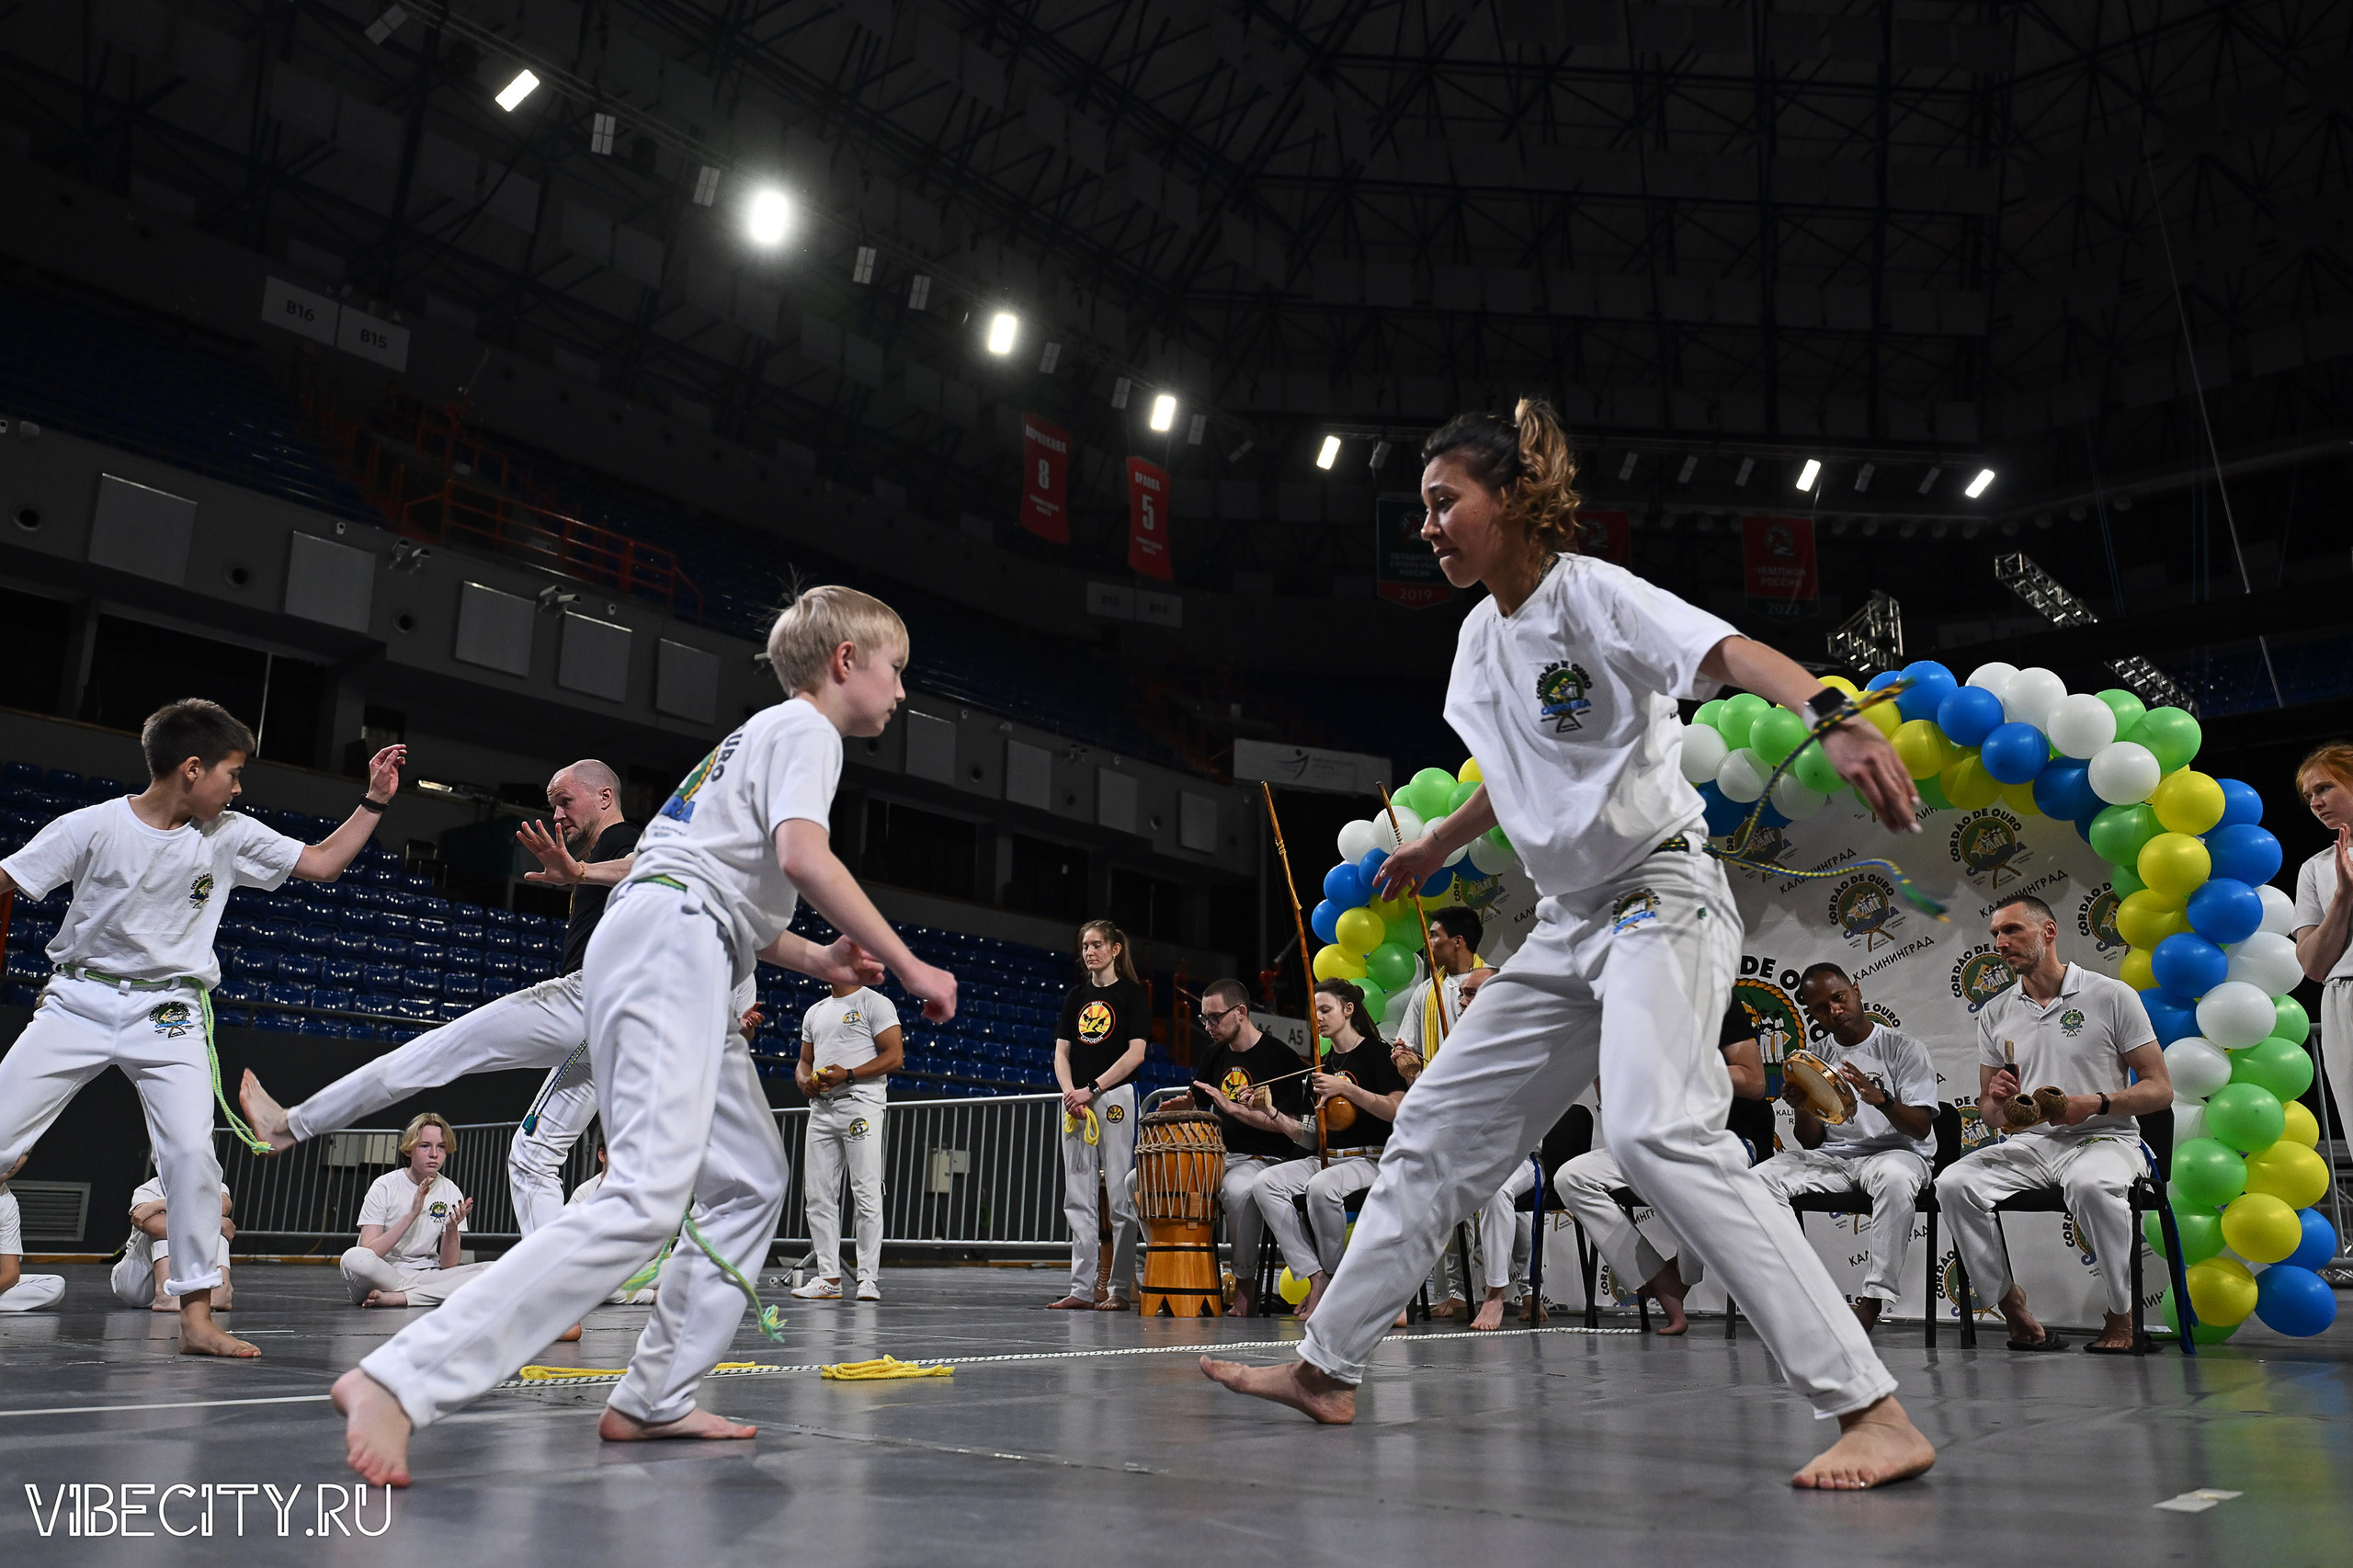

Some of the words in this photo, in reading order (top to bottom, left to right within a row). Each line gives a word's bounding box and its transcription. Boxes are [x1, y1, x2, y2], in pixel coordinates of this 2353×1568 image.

[1038, 459, 1050, 490] 8
[1142, 494, 1154, 530] 5
[1399, 588, 1432, 600] 2019
[1767, 603, 1800, 616] 2022
[1571, 664, 1593, 689] OURO
[710, 733, 743, 782] URO
[1949, 815, 1972, 863] CORDÃO
[1972, 807, 1988, 818] DE
[1991, 808, 2023, 832] OURO
[1453, 875, 1462, 902] CORD
[1829, 879, 1849, 926] CORDÃO
[1850, 873, 1866, 884] DE
[1868, 873, 1895, 897] OURO
[2077, 888, 2101, 937] CORDÃO
[2102, 882, 2112, 892] D
[1740, 955, 1777, 979] DE
[1852, 936, 1935, 983] КАЛИНИНГРАД
[1950, 950, 1973, 998] CORDÃO
[1973, 943, 1991, 955] DE
[1872, 1003, 1901, 1028] OURO
[1288, 1028, 1303, 1046] A5
[1954, 1096, 1972, 1108] DE
[2063, 1211, 2075, 1247] CORD
[1600, 1265, 1610, 1296] CORD
